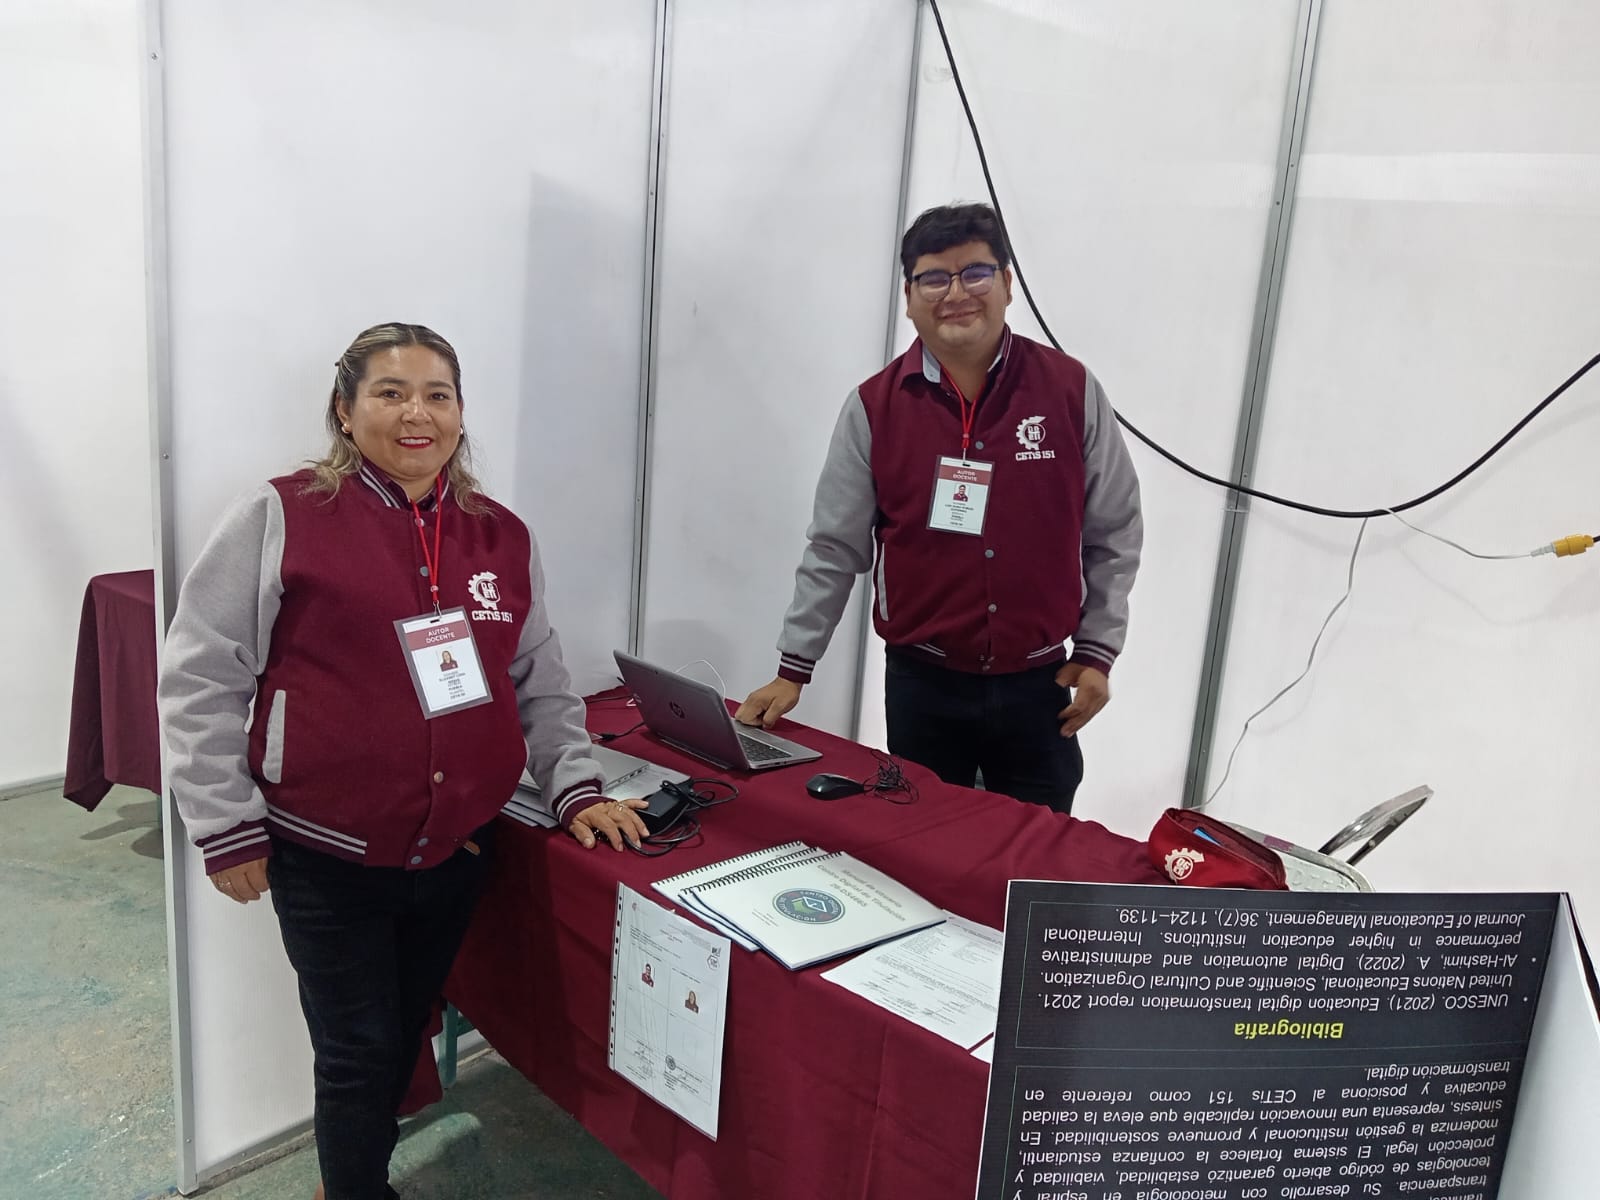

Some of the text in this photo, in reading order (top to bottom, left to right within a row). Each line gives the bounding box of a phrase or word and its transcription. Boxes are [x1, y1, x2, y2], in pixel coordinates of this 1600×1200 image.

[1042, 450, 1056, 459] 151
[952, 473, 977, 481] DOCENTE
[501, 611, 513, 623] 151
[425, 632, 455, 643] DOCENTE
[428, 626, 450, 637] AUTOR
[817, 864, 839, 879] Centro
[840, 878, 863, 893] Digital
[842, 869, 867, 884] Manual
[1215, 908, 1259, 927] 36(7),
[1265, 910, 1367, 927] Management,
[1370, 913, 1454, 928] Educational
[1457, 914, 1471, 928] of
[1474, 914, 1525, 928] Journal
[1044, 928, 1522, 950] performance in higher education institutions. International
[1042, 950, 1518, 970] Al-Hashimi, A. (2022). Digital automation and administrative
[1041, 971, 1512, 991] United Nations Educational, Scientific and Cultural Organization.
[1038, 992, 1508, 1012] UNESCO. (2021). Education digital transformation report 2021.
[1234, 1019, 1344, 1039] Bibliografía
[1365, 1062, 1510, 1080] transformación digital.
[1025, 1081, 1506, 1104] educativa y posiciona al CETis 151 como referente en
[1022, 1100, 1502, 1125] síntesis, representa una innovación replicable que eleva la calidad
[1021, 1119, 1498, 1145] moderniza la gestión institucional y promueve sostenibilidad. En
[1019, 1135, 1495, 1166] protección legal. El sistema fortalece la confianza estudiantil,
[1014, 1156, 1490, 1186] tecnologías de código abierto garantizó estabilidad, viabilidad y
[1281, 1184, 1350, 1200] desarrollo
[1363, 1183, 1382, 1195] Su
[1397, 1175, 1486, 1193] transparencia.
[1013, 1190, 1022, 1200] y
[1038, 1190, 1088, 1200] espiral
[1103, 1192, 1122, 1200] en
[1242, 1188, 1267, 1198] con
